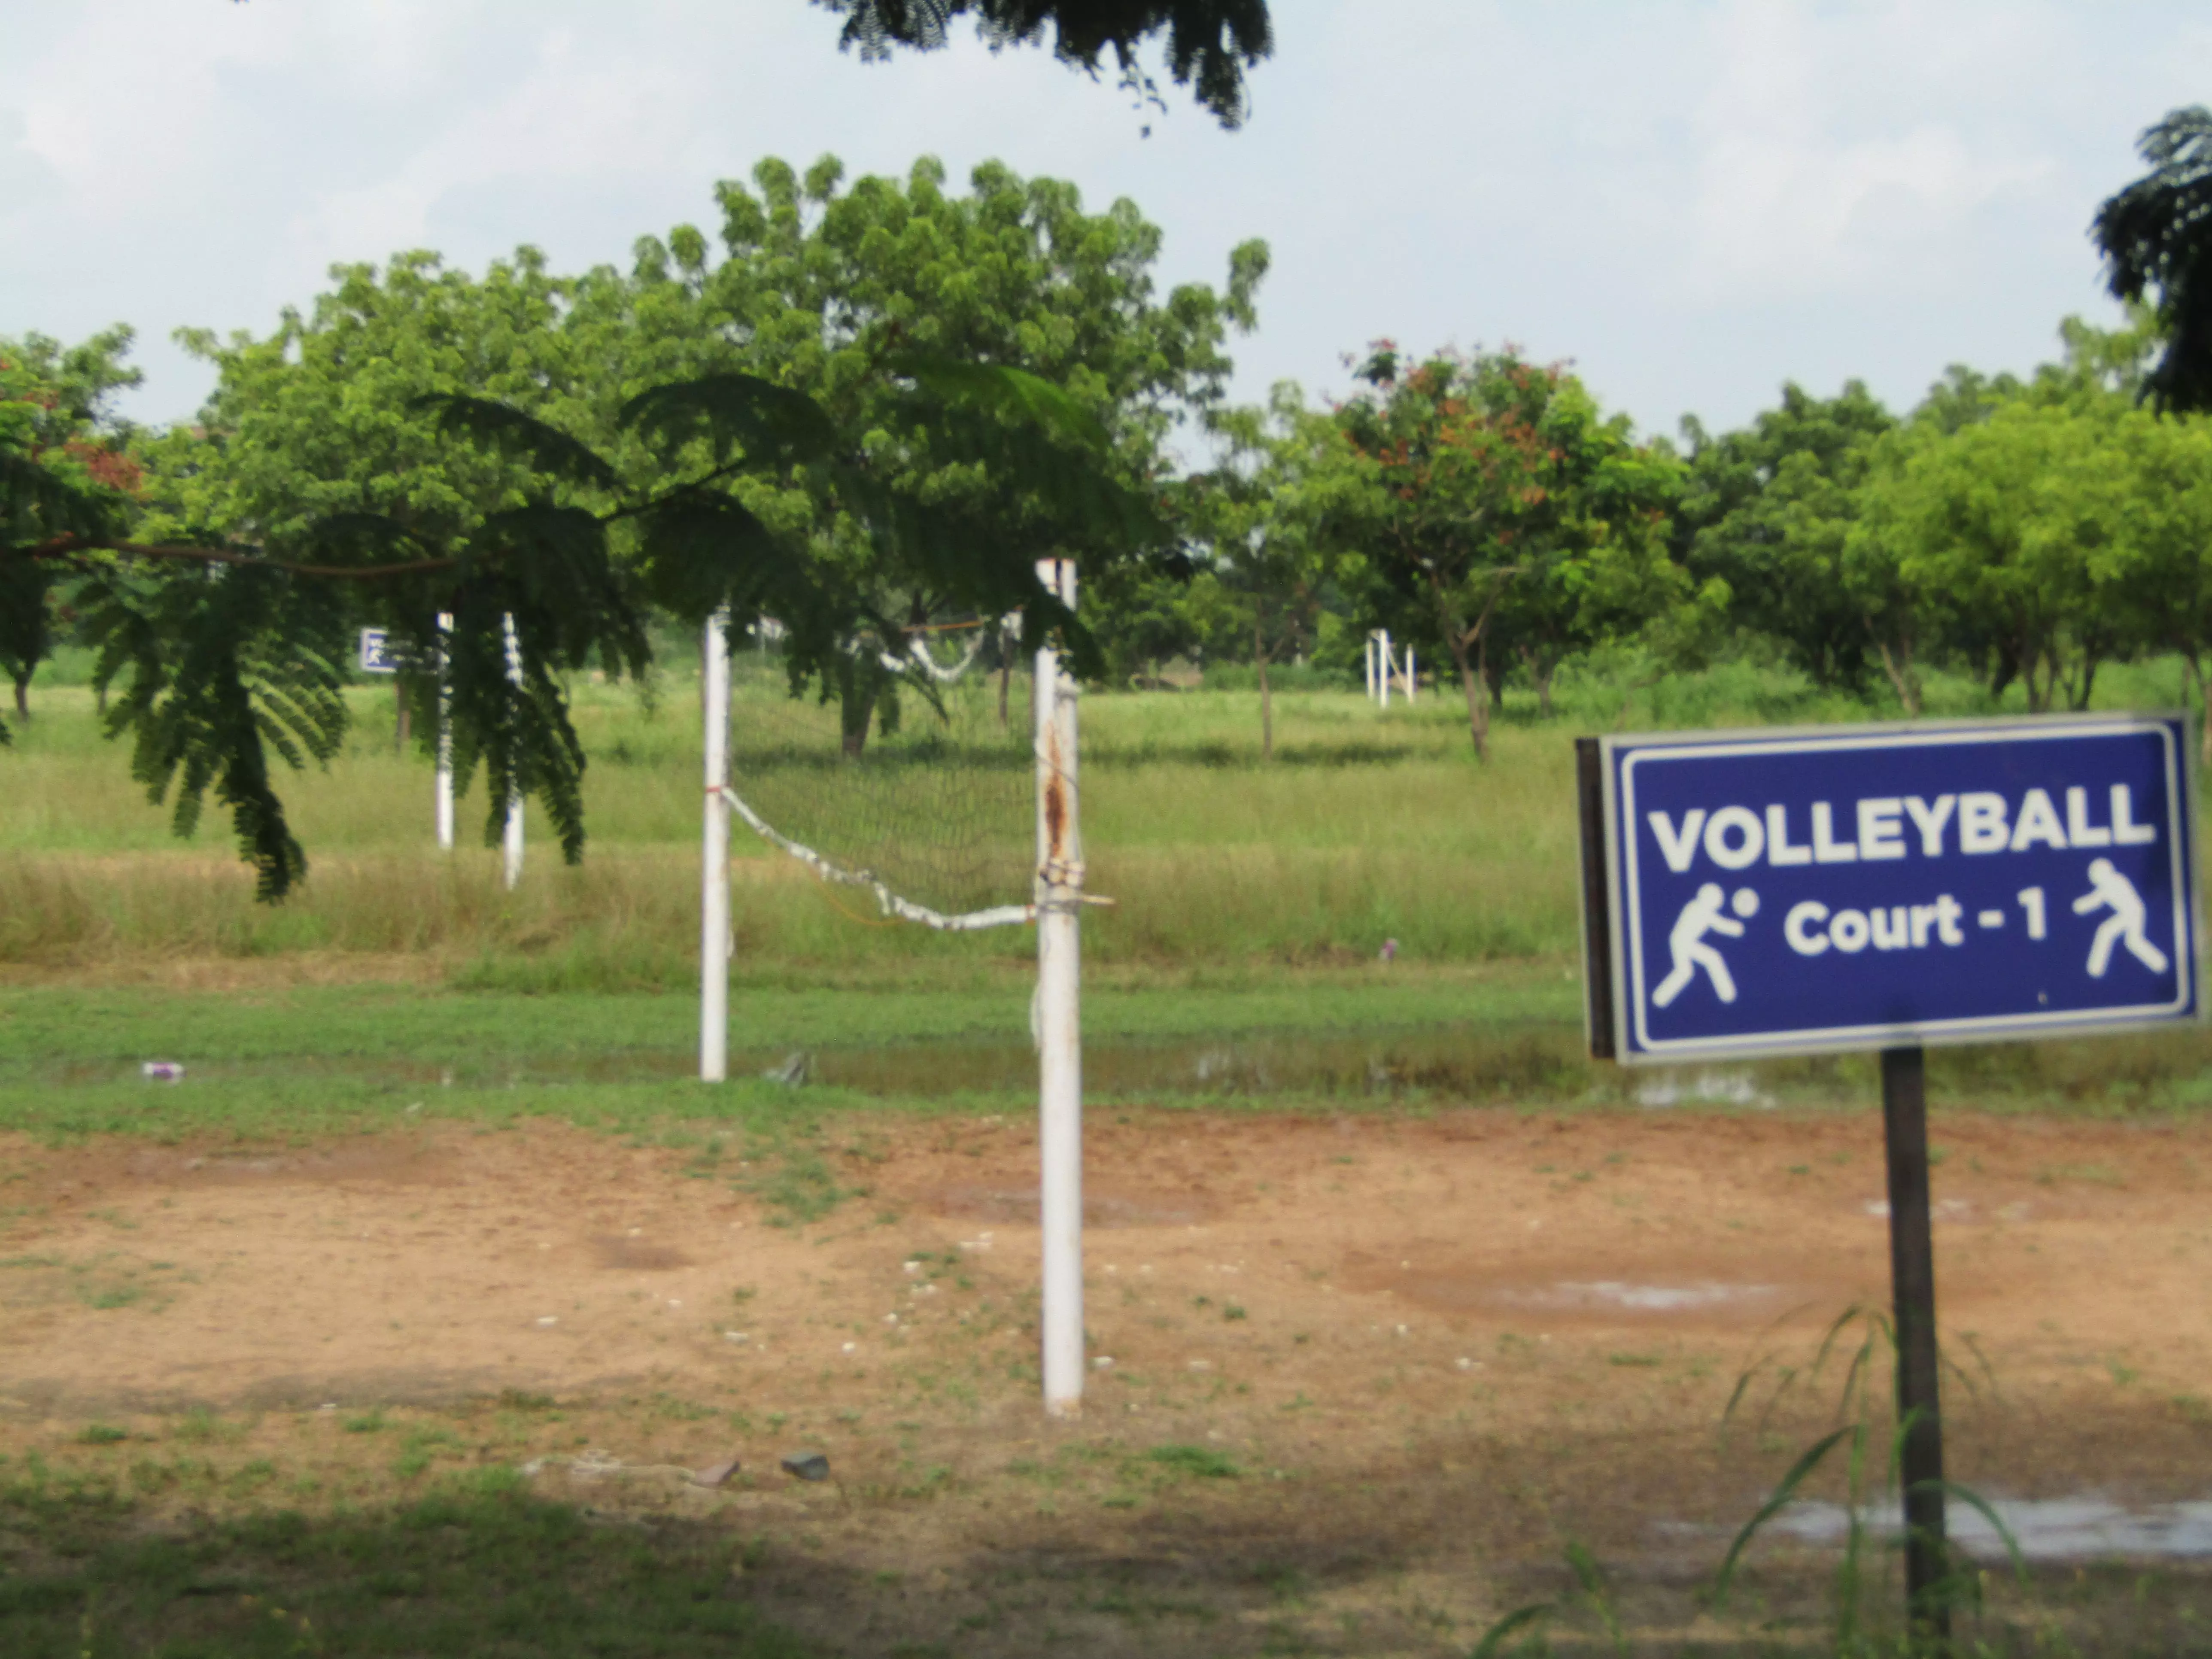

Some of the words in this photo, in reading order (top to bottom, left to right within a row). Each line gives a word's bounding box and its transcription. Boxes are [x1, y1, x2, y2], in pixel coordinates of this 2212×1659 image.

[1647, 784, 2155, 872] VOLLEYBALL
[1784, 894, 1964, 956] Court
[2018, 886, 2045, 939] 1
